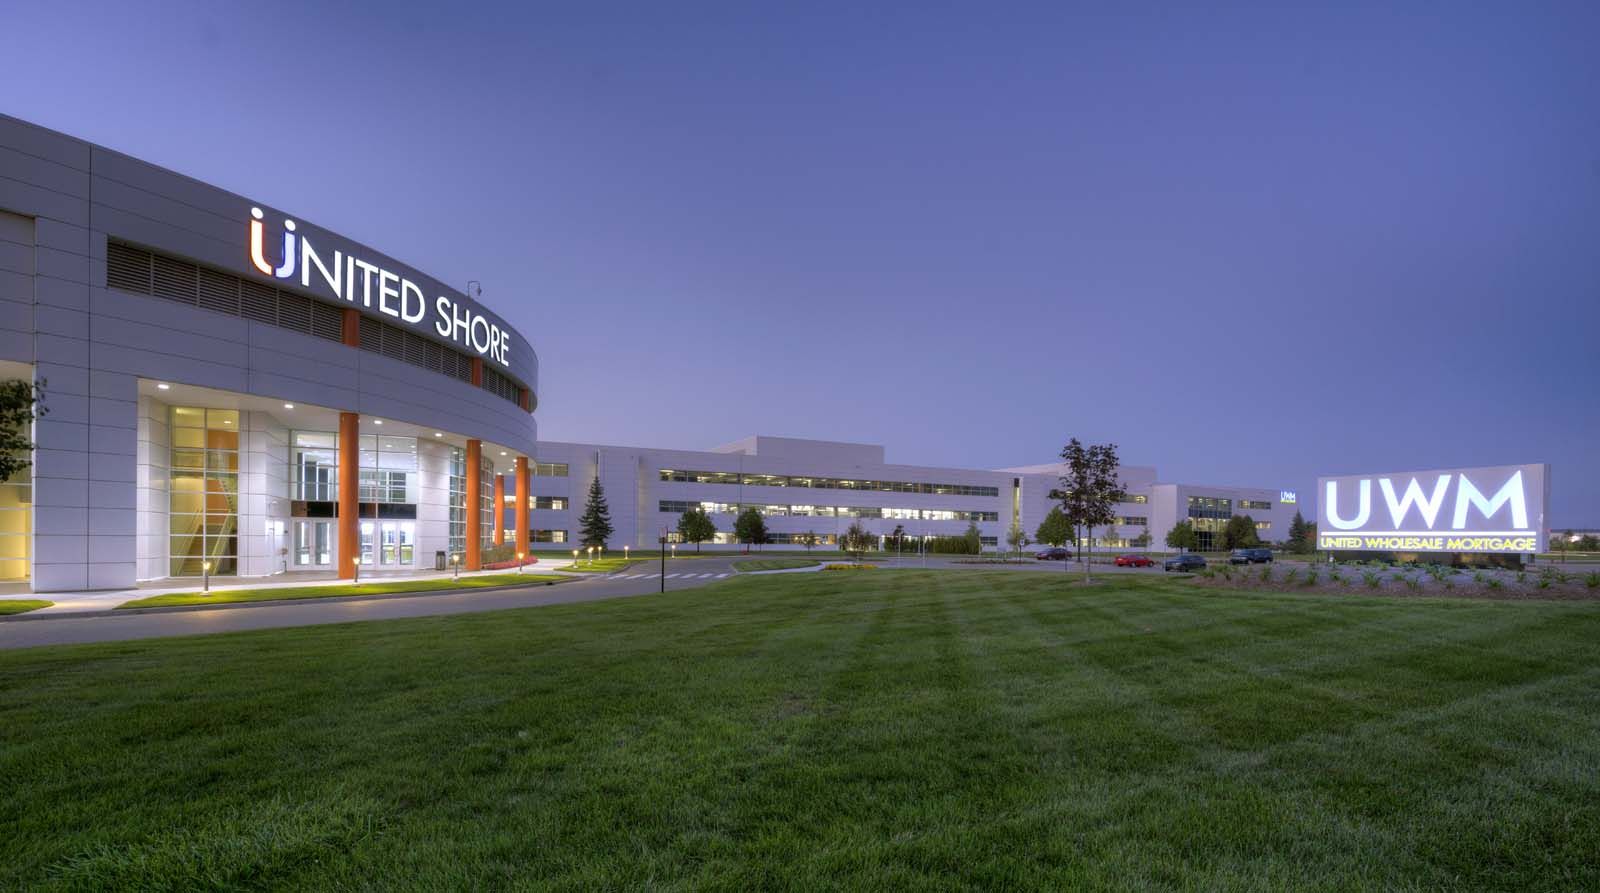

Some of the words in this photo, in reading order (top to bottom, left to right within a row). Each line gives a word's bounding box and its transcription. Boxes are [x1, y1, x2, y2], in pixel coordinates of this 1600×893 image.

[250, 207, 425, 324] UNITED
[435, 296, 510, 368] SHORE
[1326, 470, 1529, 530] UWM
[1321, 537, 1362, 549] UNITED
[1365, 537, 1443, 550] WHOLESALE
[1446, 537, 1536, 551] MORTGAGE
